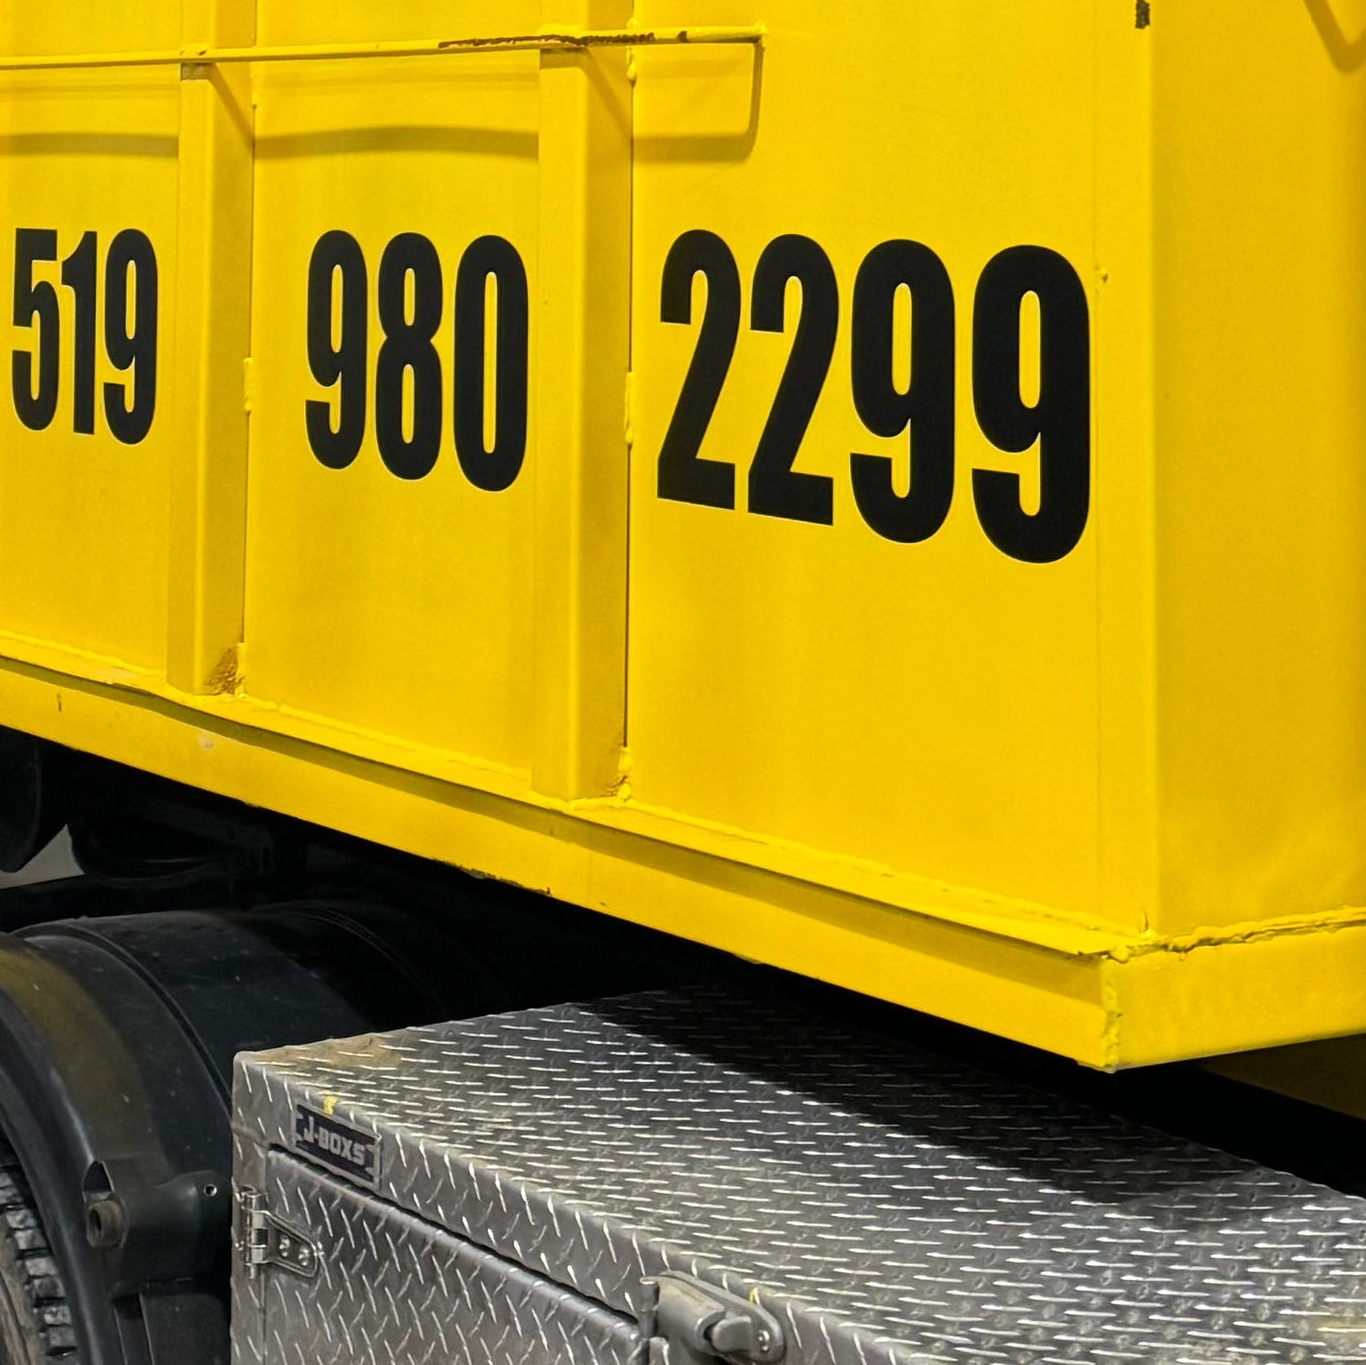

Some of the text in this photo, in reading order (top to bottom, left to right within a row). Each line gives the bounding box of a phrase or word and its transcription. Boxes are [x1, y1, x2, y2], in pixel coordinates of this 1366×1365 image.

[11, 228, 1092, 564] 519 980 2299
